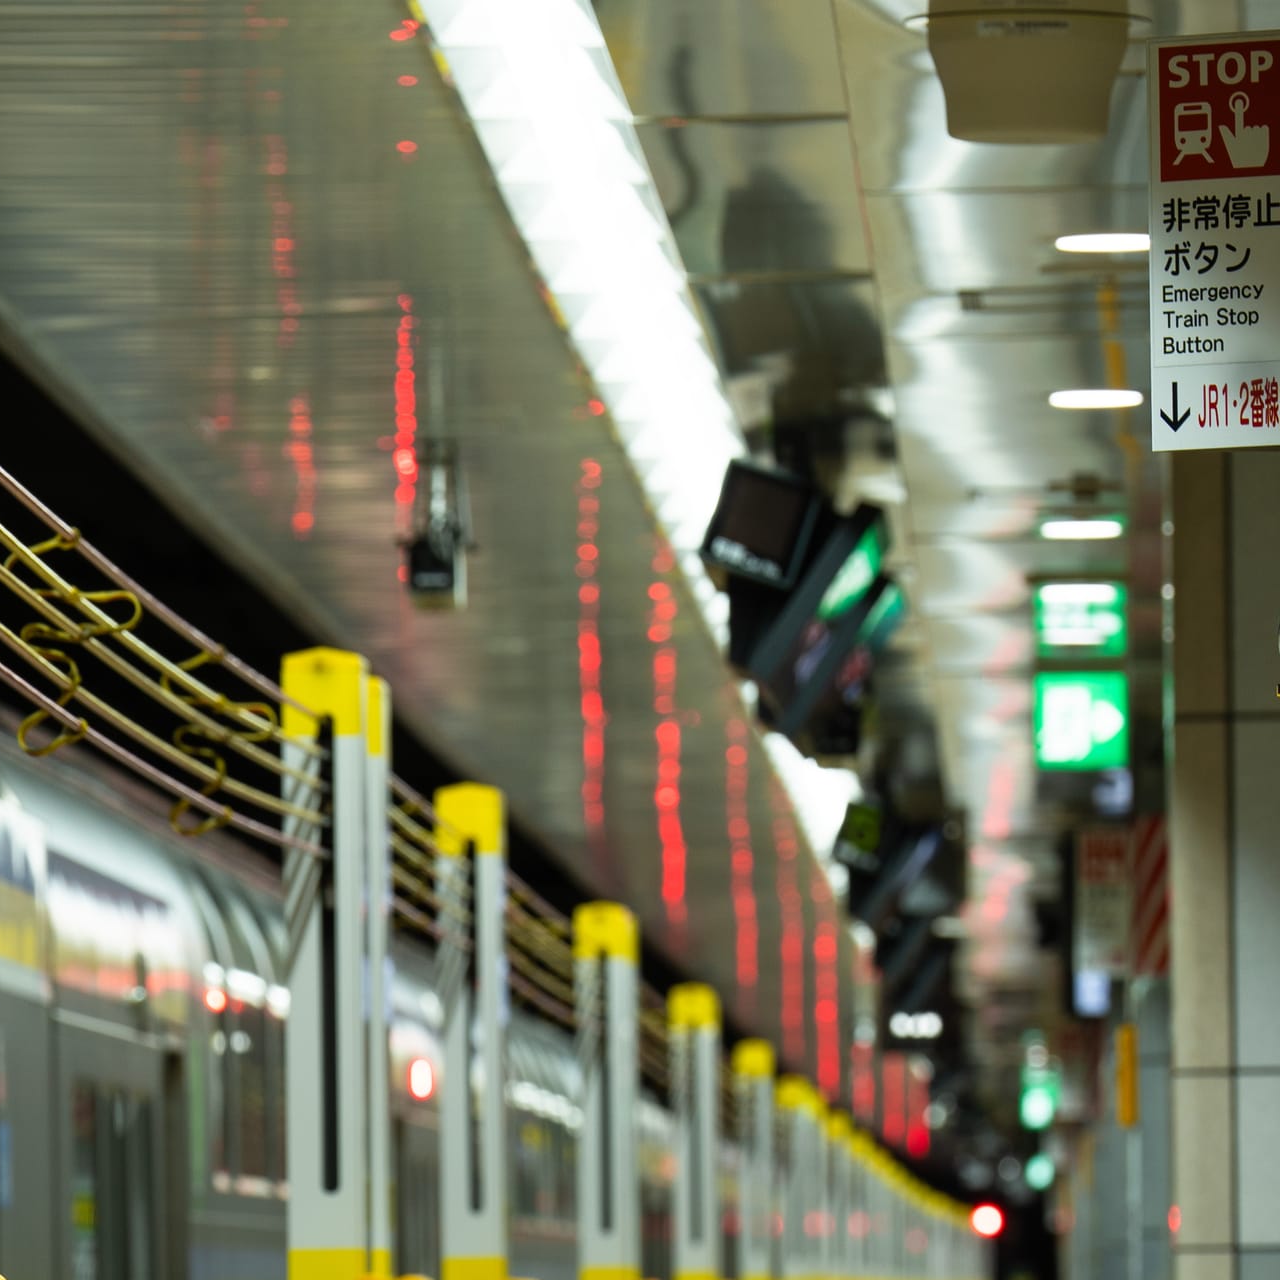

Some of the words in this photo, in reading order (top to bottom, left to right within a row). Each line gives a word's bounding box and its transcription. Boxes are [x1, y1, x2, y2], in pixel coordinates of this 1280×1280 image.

[1168, 50, 1274, 89] STOP
[1163, 192, 1280, 232] 非常停止
[1164, 241, 1251, 276] ボタン
[1162, 283, 1264, 303] Emergency
[1163, 309, 1209, 328] Train
[1216, 307, 1260, 326] Stop
[1163, 336, 1224, 354] Button
